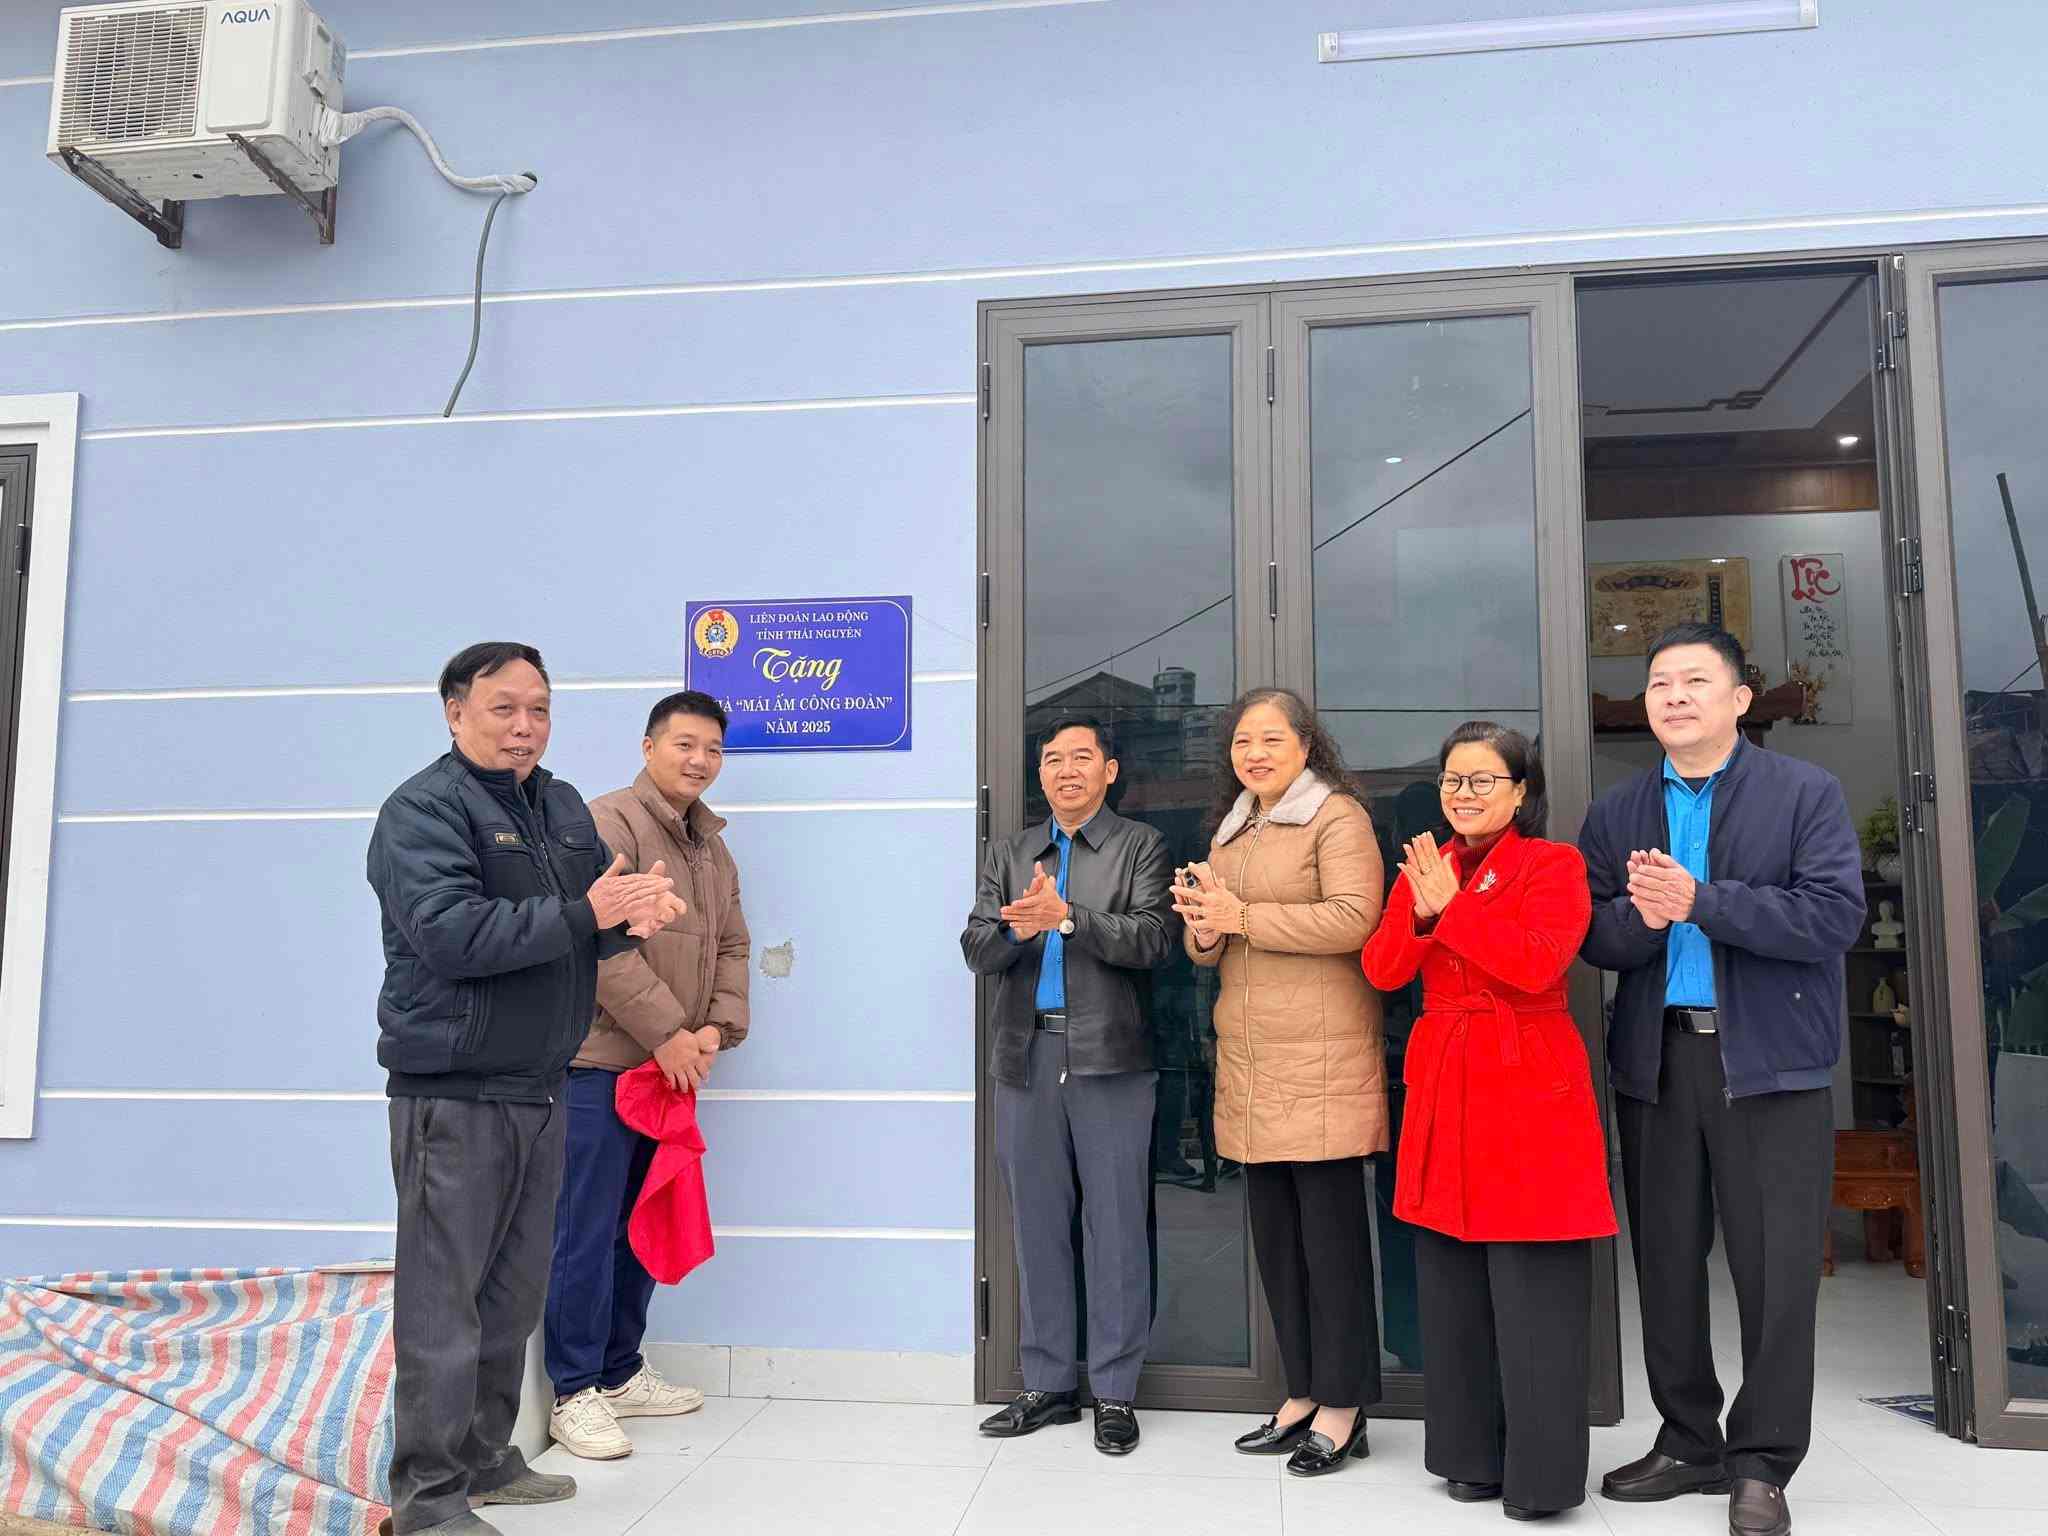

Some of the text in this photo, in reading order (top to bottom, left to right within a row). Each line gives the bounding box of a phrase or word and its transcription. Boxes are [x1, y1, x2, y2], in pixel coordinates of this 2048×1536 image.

[221, 8, 271, 25] AQUA
[812, 612, 834, 623] LAO
[837, 609, 869, 624] ĐỘNG
[786, 626, 813, 640] THÁI
[815, 626, 862, 640] NGUYÊN
[752, 647, 843, 691] Tặng
[800, 693, 841, 711] CÔNG
[766, 718, 832, 734] NĂM 2025
